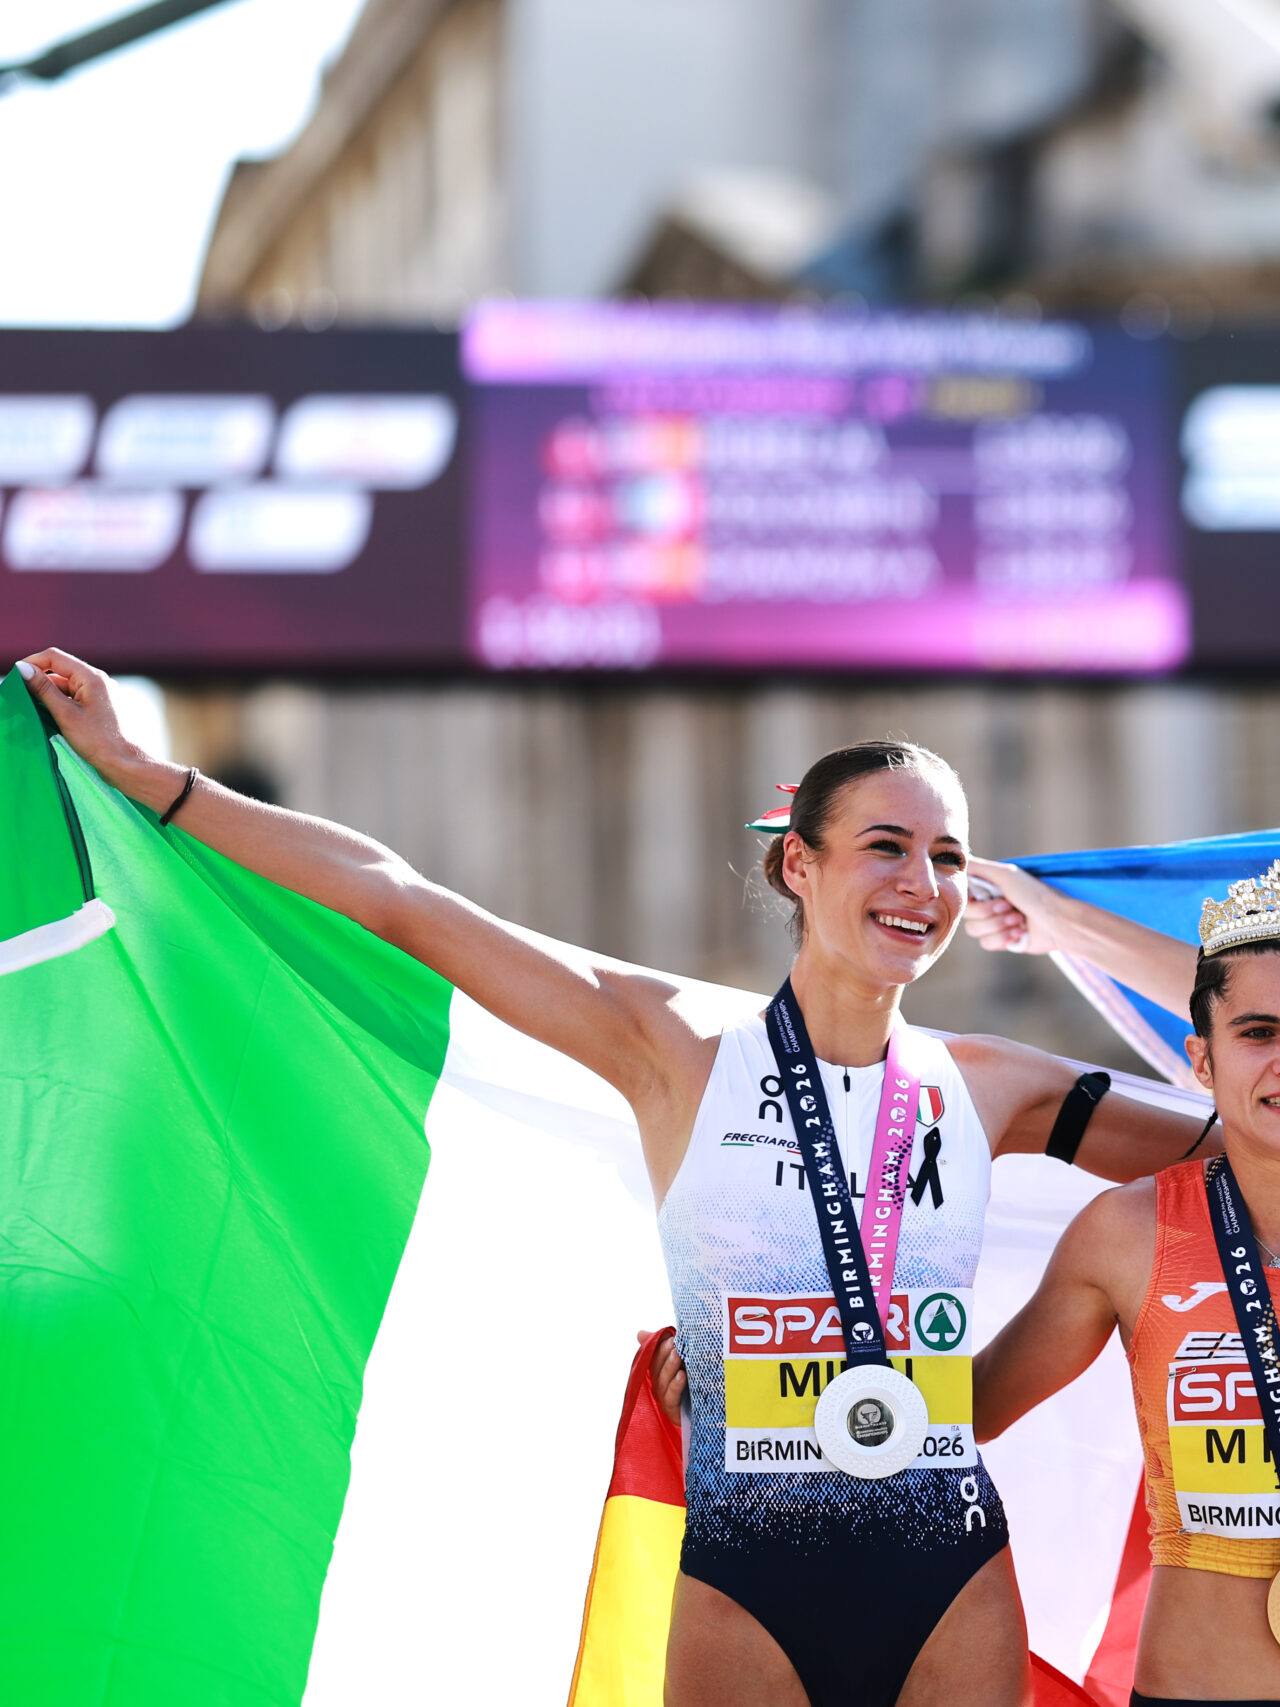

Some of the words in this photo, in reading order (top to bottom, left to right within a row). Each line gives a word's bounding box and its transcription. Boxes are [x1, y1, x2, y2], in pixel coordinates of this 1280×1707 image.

[722, 1132, 800, 1150] FRECCIAROS
[812, 1142, 865, 1308] BIRMINGHAM
[867, 1150, 900, 1296] RMINGHAM
[736, 1439, 822, 1462] BIRMIN
[917, 1436, 965, 1458] 026
[1205, 1428, 1246, 1464] M
